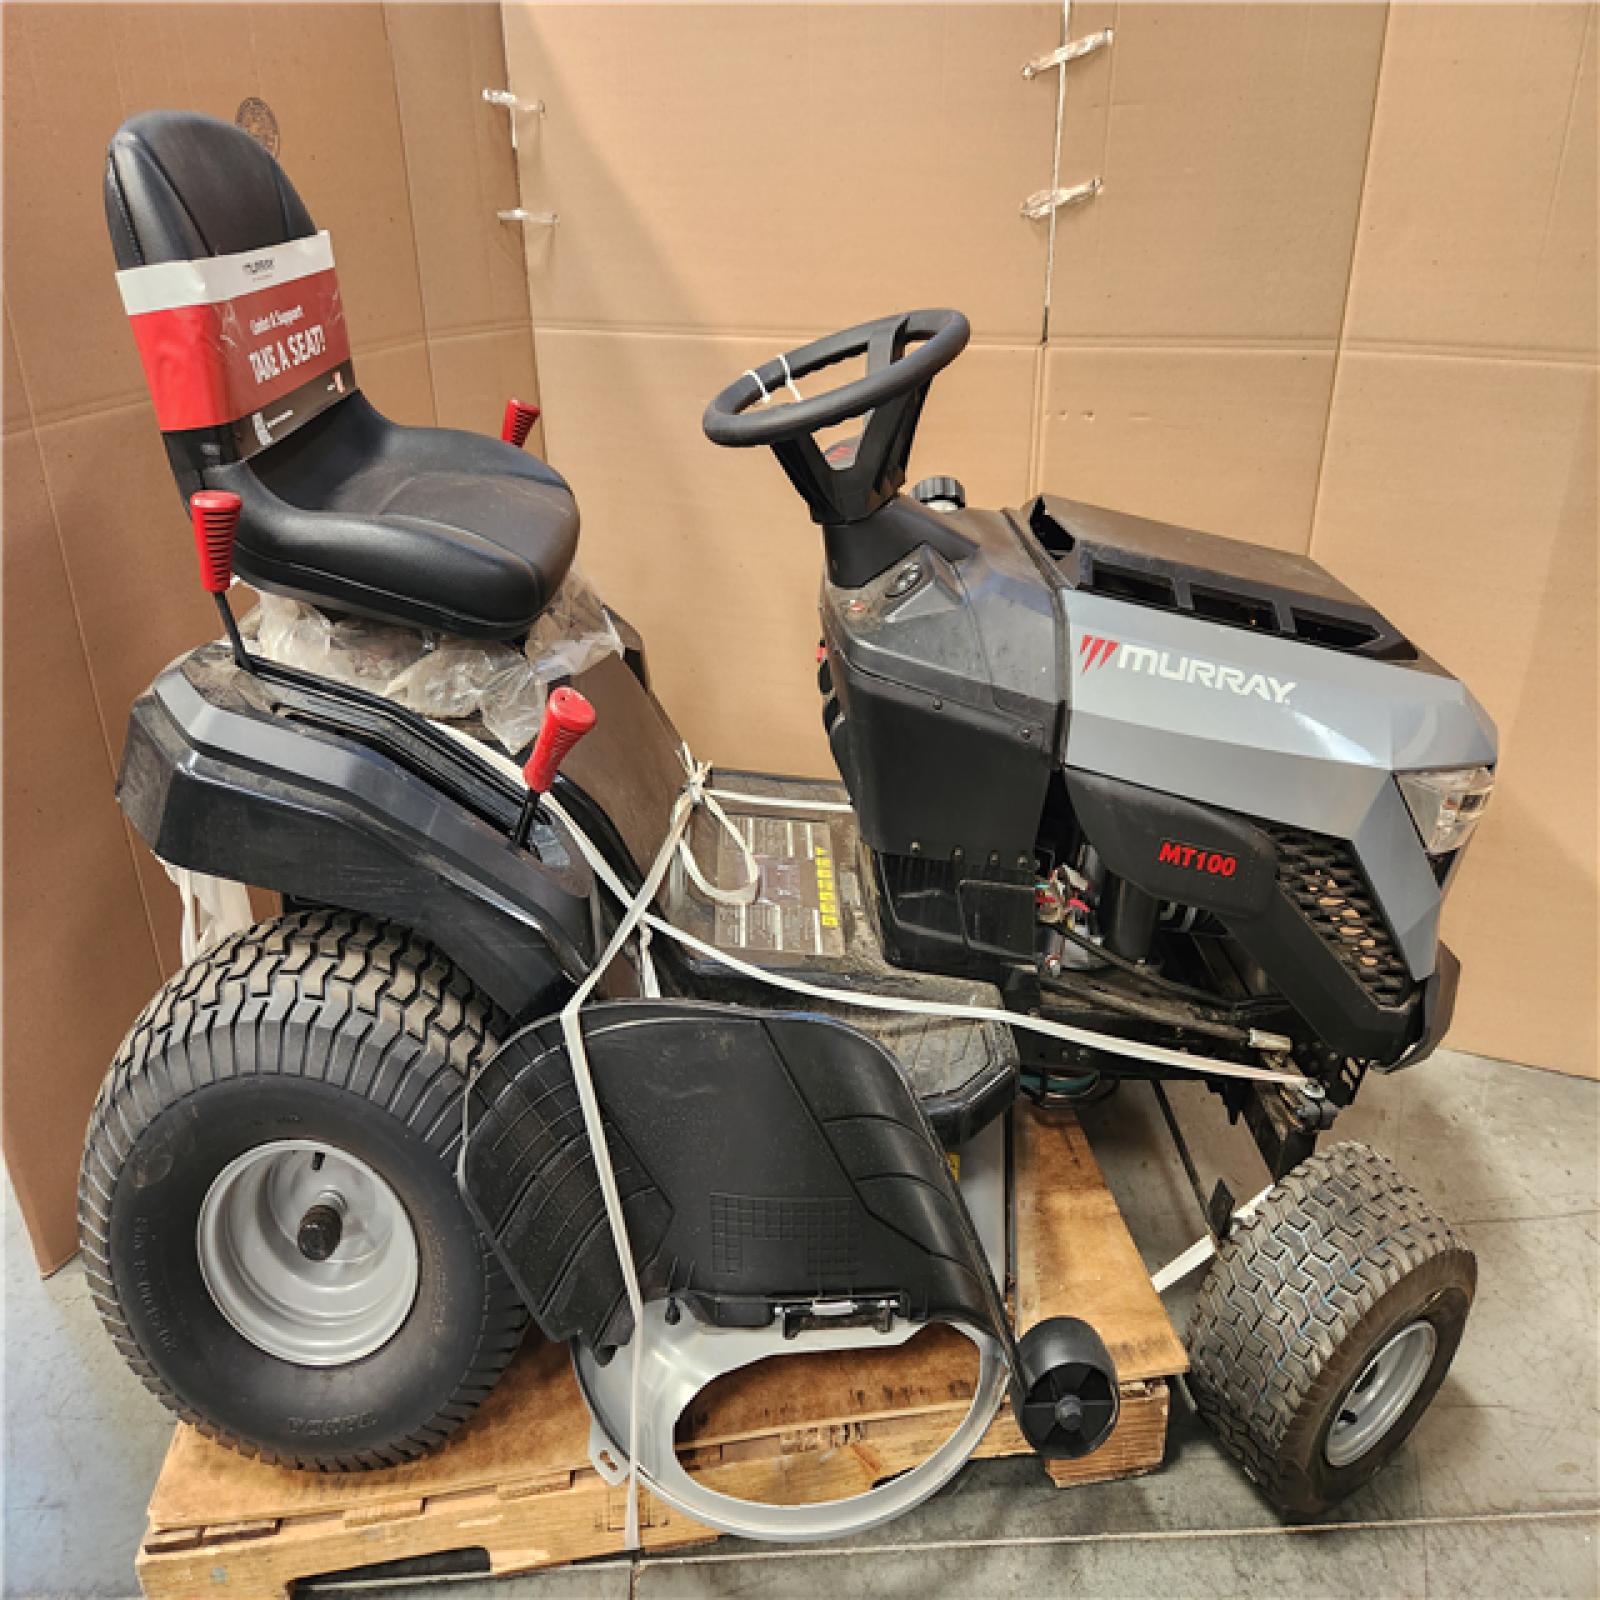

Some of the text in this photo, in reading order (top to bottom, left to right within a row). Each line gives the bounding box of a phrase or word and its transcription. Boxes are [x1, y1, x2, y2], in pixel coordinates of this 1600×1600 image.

[278, 341, 290, 371] A
[1117, 644, 1296, 703] MURRAY
[1159, 841, 1237, 876] MT100
